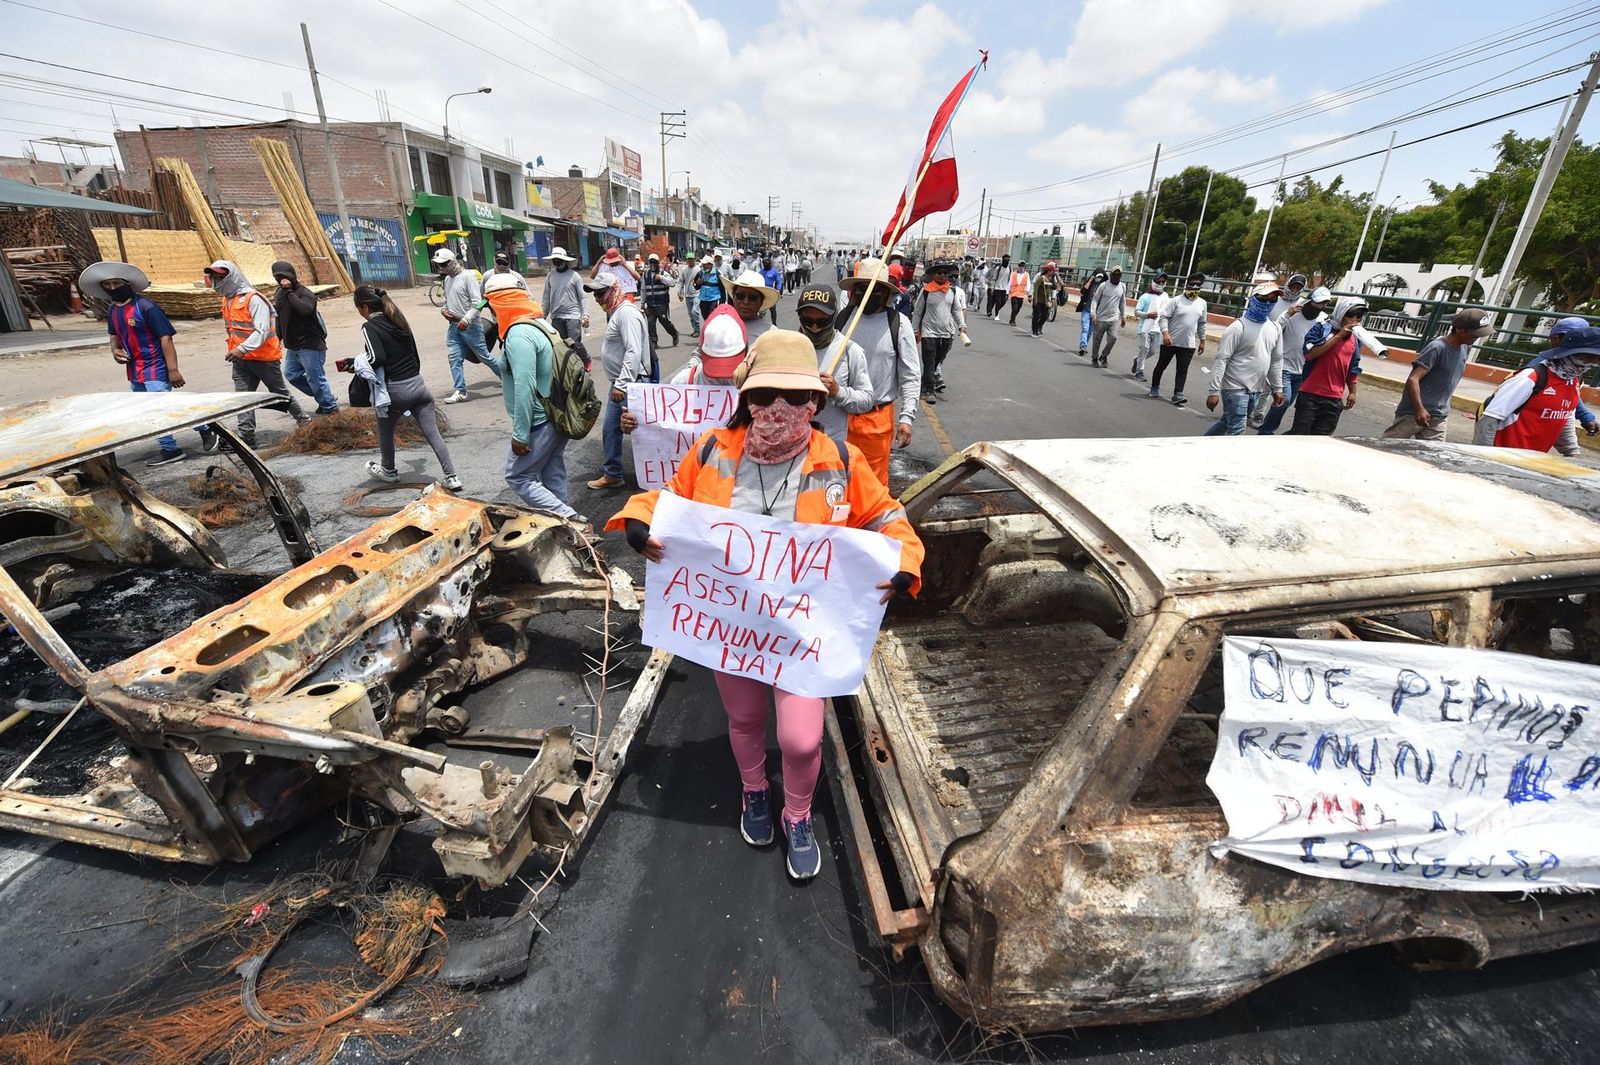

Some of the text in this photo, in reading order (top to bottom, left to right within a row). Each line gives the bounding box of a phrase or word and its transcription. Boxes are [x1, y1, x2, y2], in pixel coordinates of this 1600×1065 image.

[802, 290, 830, 303] PERÚ
[642, 386, 734, 425] URGEN
[1561, 399, 1572, 409] Fly
[710, 521, 832, 585] DINA
[663, 566, 811, 620] ASESINA
[671, 602, 823, 663] RENUNCIA
